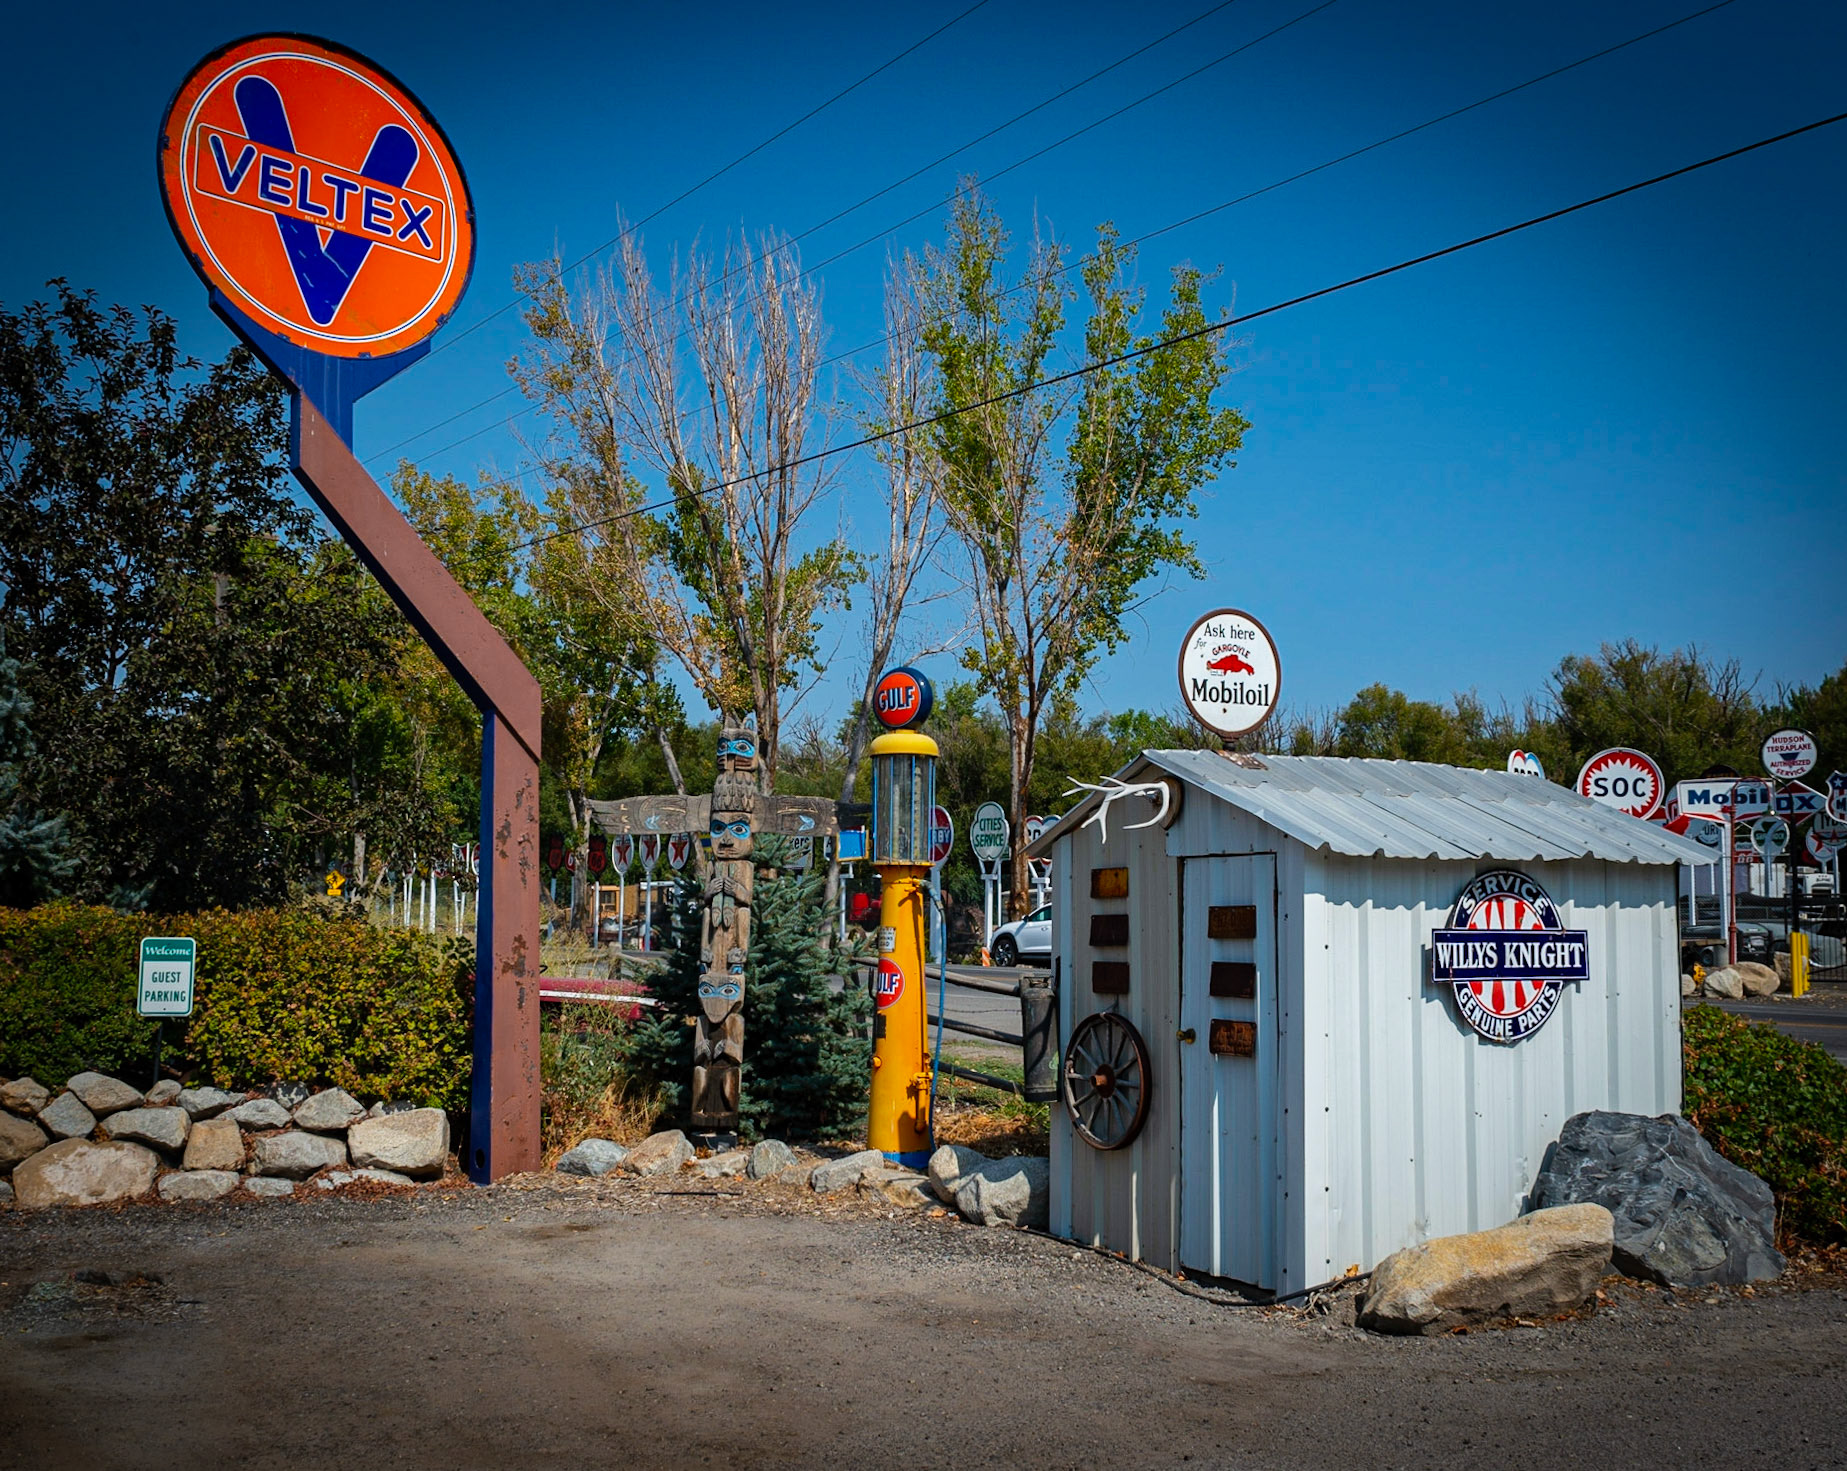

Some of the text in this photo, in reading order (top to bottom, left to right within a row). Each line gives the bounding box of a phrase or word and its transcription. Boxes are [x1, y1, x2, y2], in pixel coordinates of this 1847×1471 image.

[208, 134, 433, 249] VELTEX
[1204, 623, 1255, 640] Ask here
[1194, 638, 1207, 649] for
[1212, 644, 1250, 659] GARGOYLE
[879, 686, 915, 713] GULF
[1192, 678, 1270, 706] Mobiloil
[1772, 735, 1805, 744] HUDSON
[1767, 744, 1812, 752] TERRAPLANE
[1594, 777, 1646, 798] SOC
[1688, 788, 1769, 804] Mobil
[1776, 795, 1818, 811] DX
[980, 818, 1002, 831] CITIES
[974, 834, 1004, 847] SERVICE
[1462, 875, 1549, 916] SERVICE
[145, 945, 192, 955] Welcome
[1436, 942, 1584, 969] WILLYS KNIGHT
[152, 971, 181, 983] GUEST
[144, 990, 186, 1002] PARKING
[1460, 985, 1557, 1036] GENUINE PARTS
